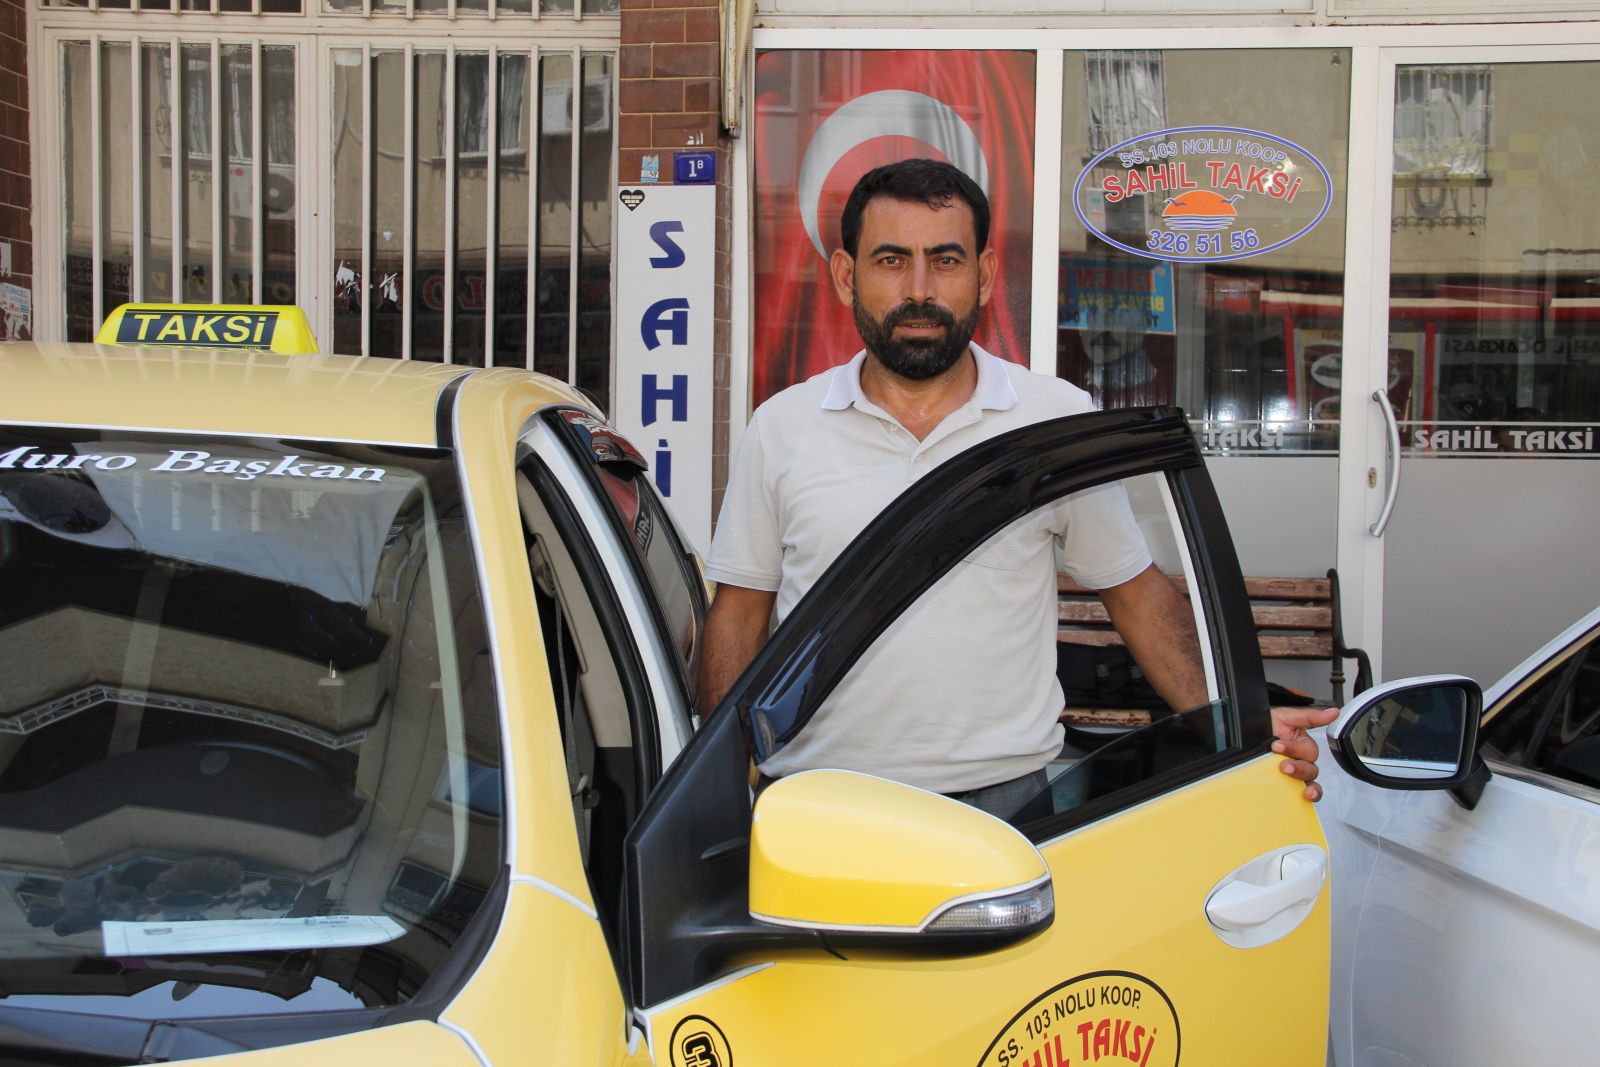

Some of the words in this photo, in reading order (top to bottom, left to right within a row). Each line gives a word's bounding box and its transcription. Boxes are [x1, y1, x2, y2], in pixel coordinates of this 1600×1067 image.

[1183, 138, 1232, 155] NOLU
[1146, 229, 1189, 254] 326
[1195, 234, 1222, 254] 51
[1230, 228, 1259, 251] 56
[1414, 426, 1498, 450] SAHİL
[1508, 428, 1593, 451] TAKSİ
[149, 449, 387, 481] Başkan
[1026, 1009, 1051, 1040] 103
[1055, 987, 1095, 1021] NOLU
[1100, 985, 1141, 1010] KOOP.
